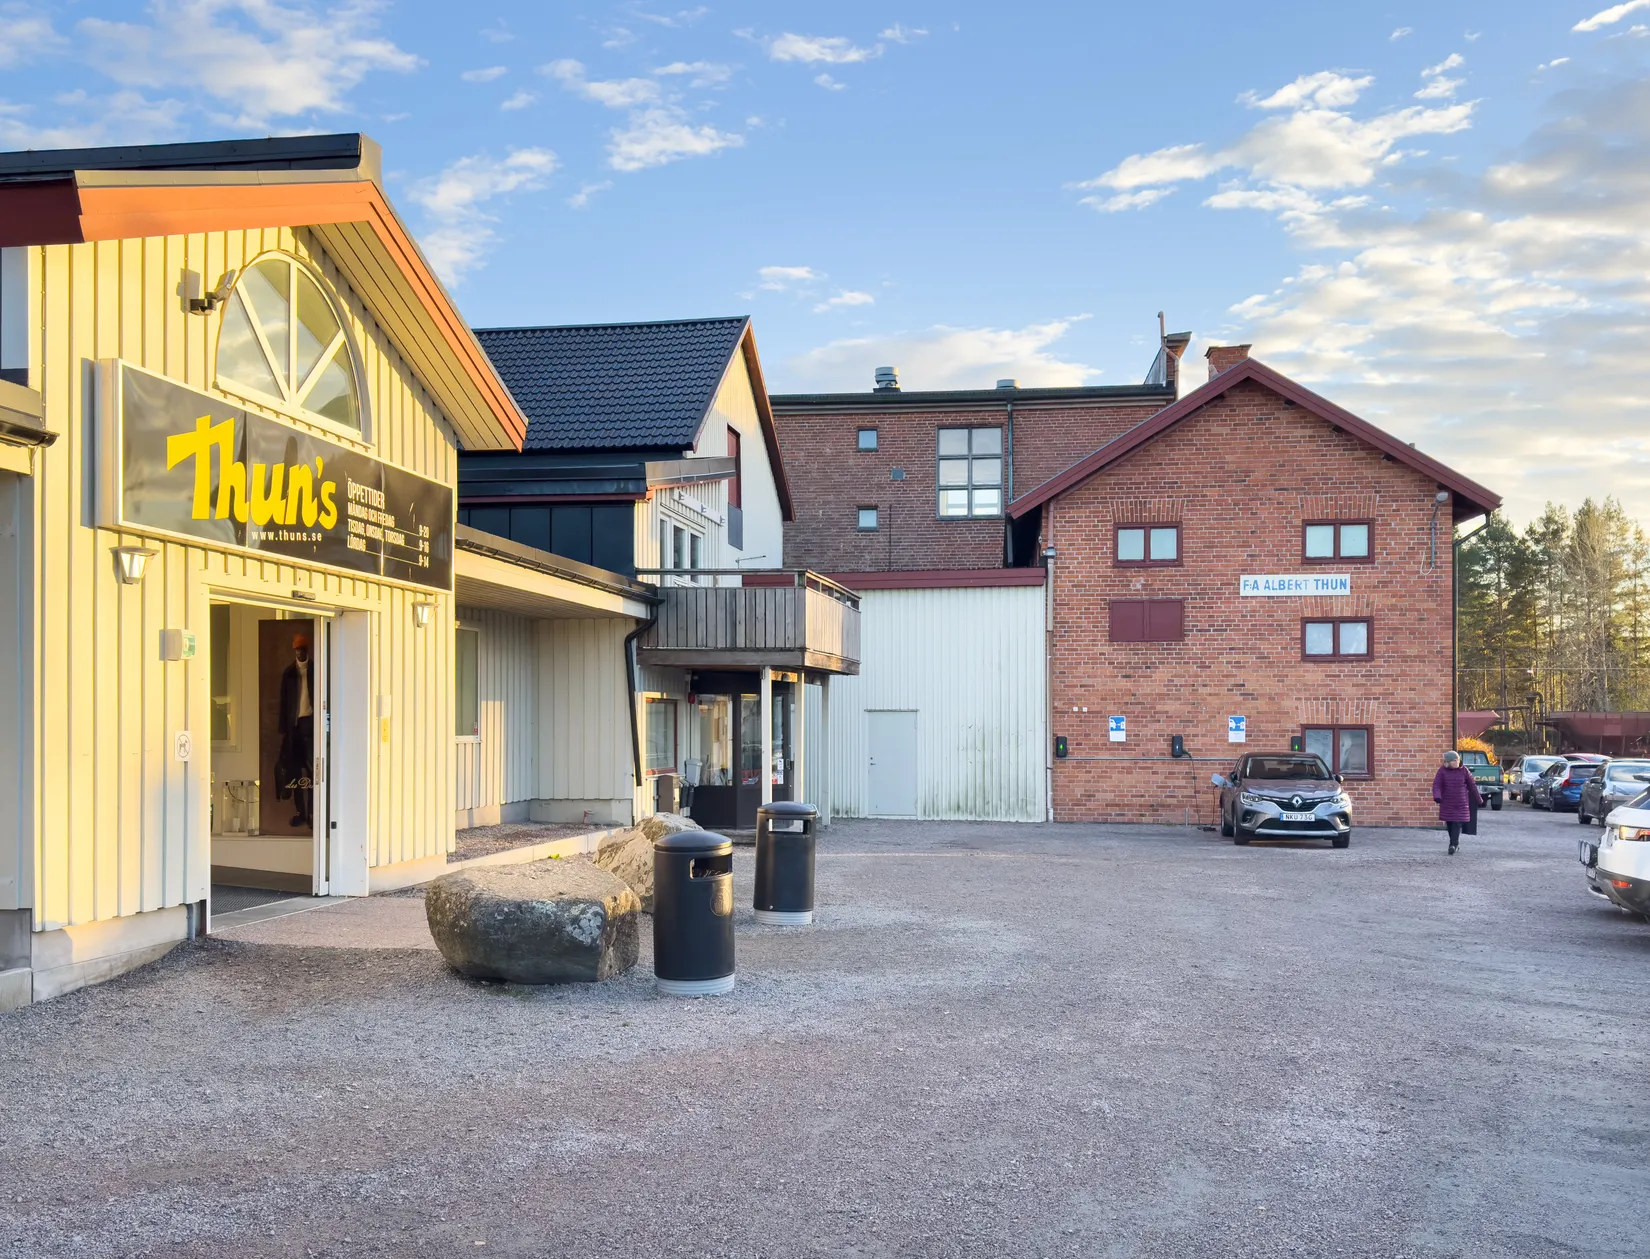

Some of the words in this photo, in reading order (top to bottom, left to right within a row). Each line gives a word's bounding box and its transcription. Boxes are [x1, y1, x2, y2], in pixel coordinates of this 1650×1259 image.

[167, 415, 338, 530] Thun's
[347, 477, 385, 510] ÖPPETTIDER
[251, 529, 323, 542] www.thuns.se
[347, 500, 368, 521] MÅNDAG
[368, 508, 378, 524] OCH
[418, 524, 430, 539] 9-20
[1263, 579, 1310, 591] ALBERT
[1314, 578, 1347, 591] THUN
